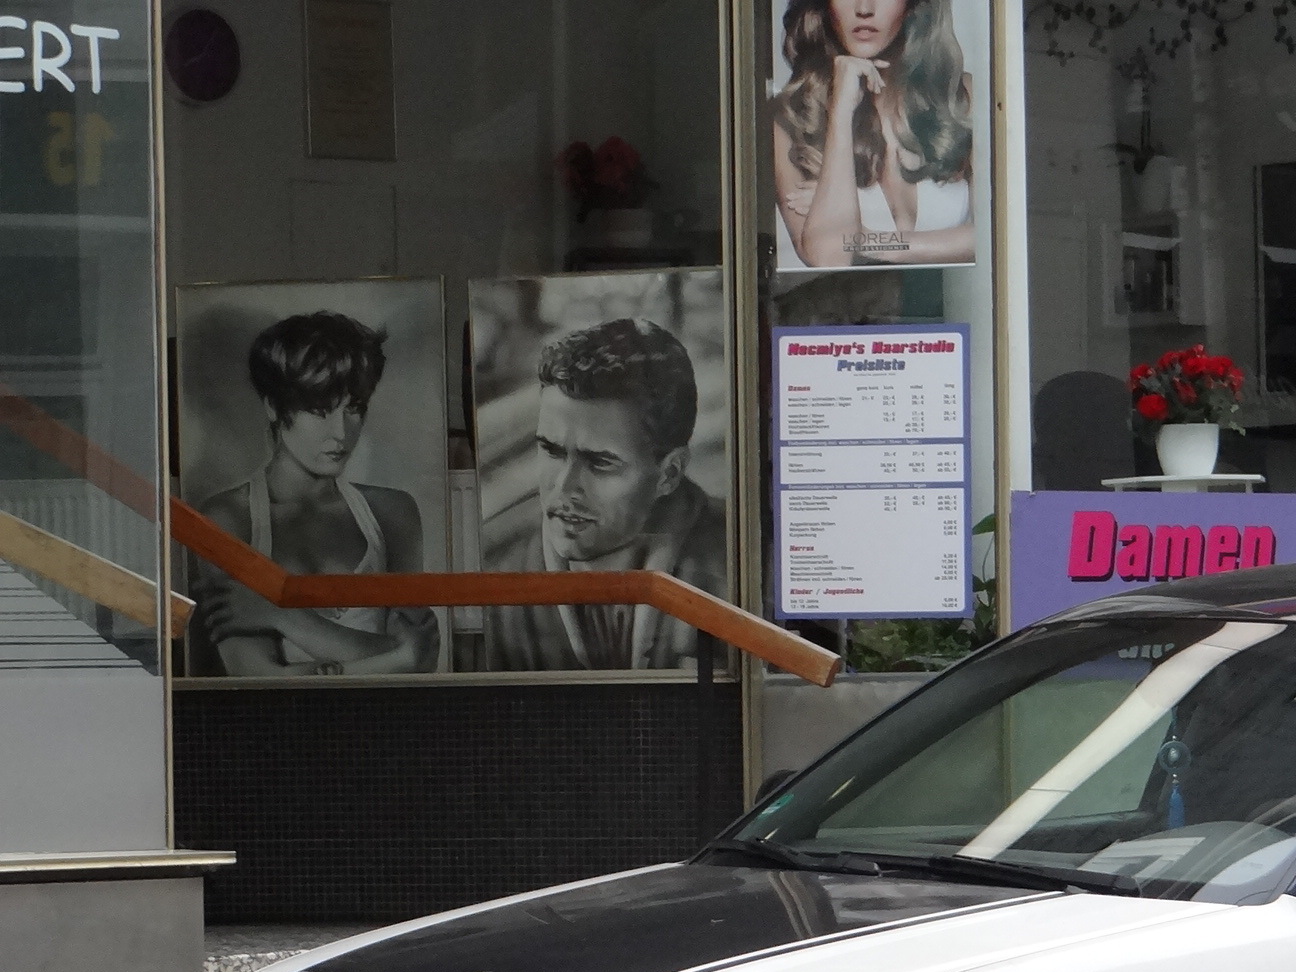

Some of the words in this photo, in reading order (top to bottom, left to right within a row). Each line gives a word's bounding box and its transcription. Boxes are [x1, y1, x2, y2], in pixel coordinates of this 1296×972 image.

[0, 16, 120, 94] ERT
[836, 358, 907, 372] Preisliste
[872, 339, 956, 354] Haarstudio
[1067, 511, 1276, 581] Damen
